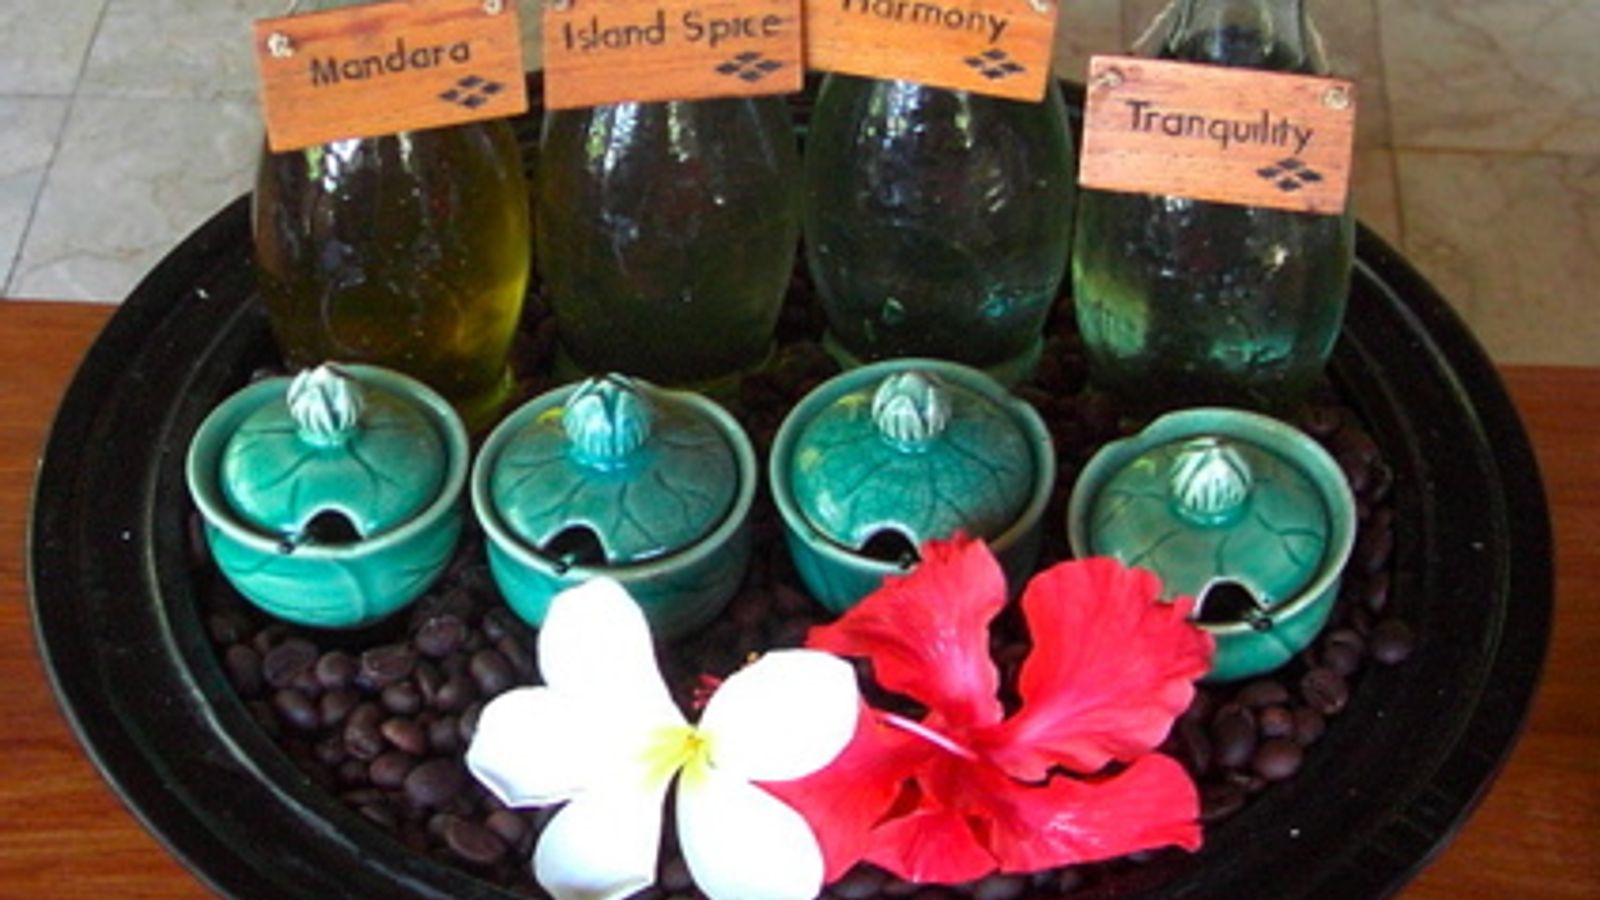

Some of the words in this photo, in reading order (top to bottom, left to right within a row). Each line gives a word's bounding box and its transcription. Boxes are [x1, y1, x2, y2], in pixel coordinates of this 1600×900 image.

[563, 10, 665, 49] Island
[682, 10, 782, 47] Spice
[310, 37, 470, 86] Mandara
[1127, 100, 1314, 154] Tranquility
